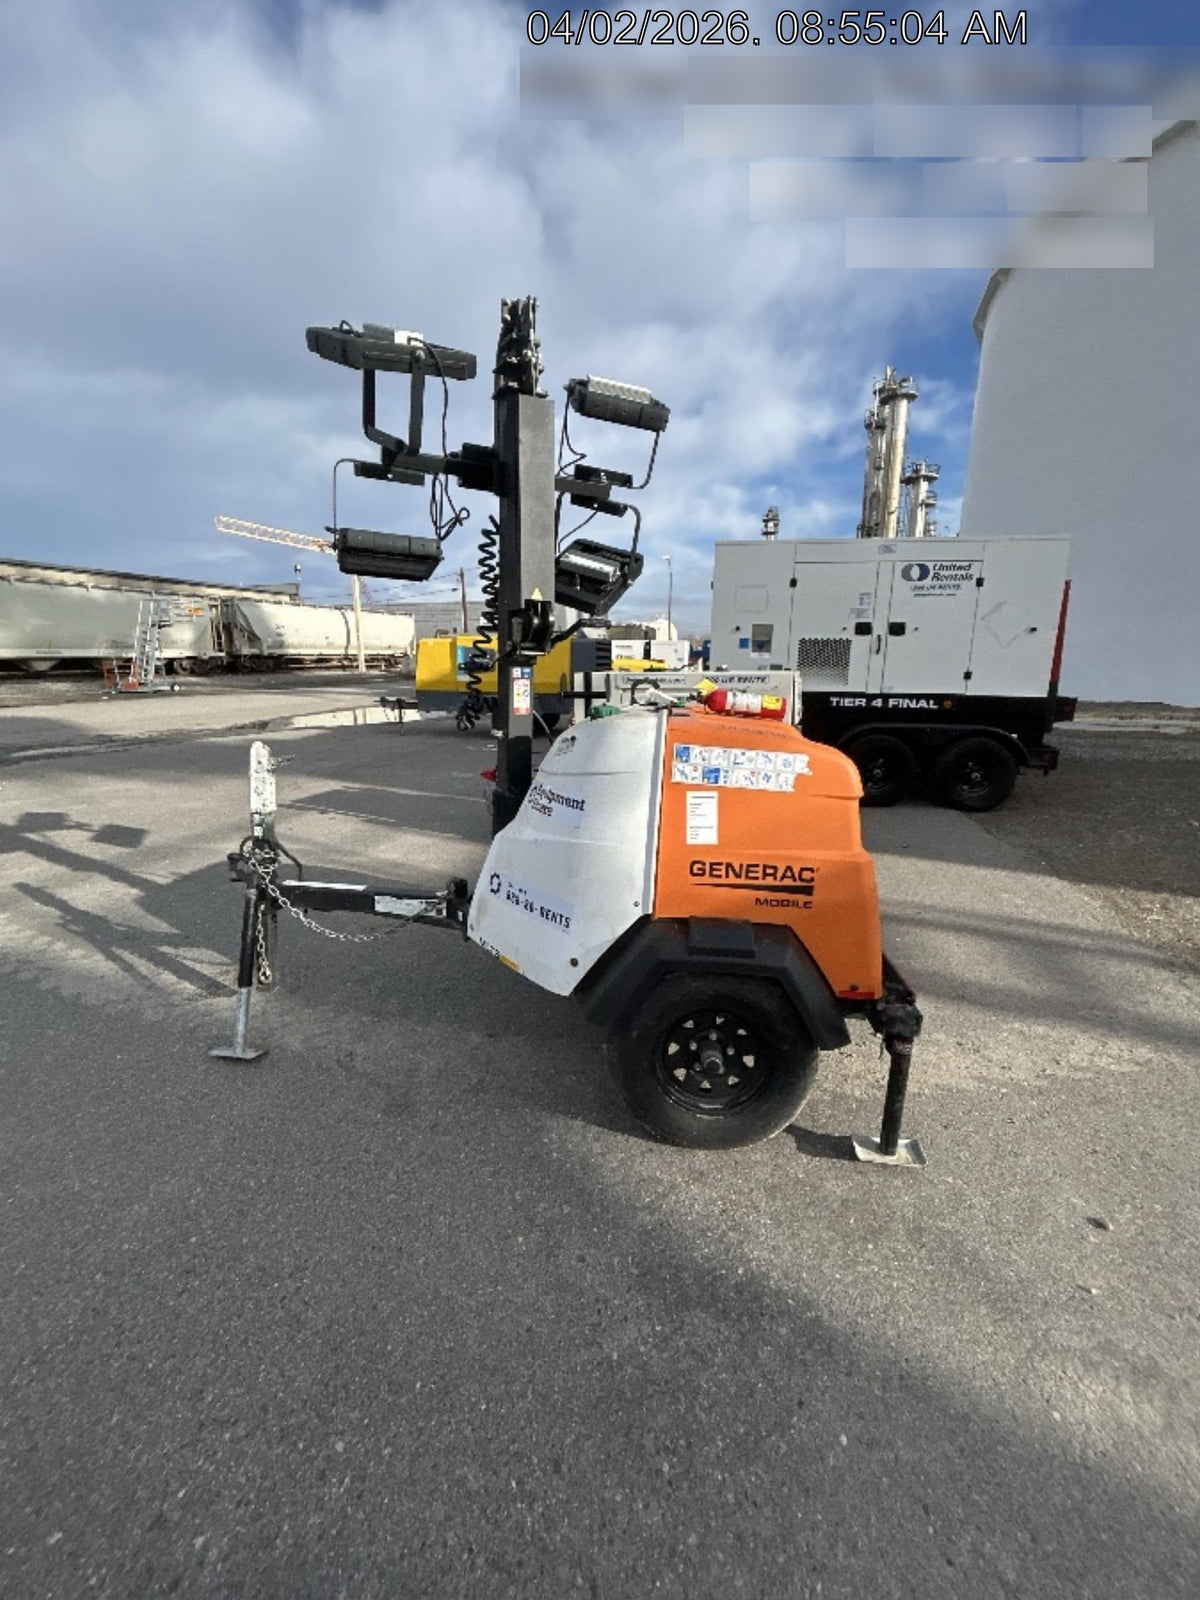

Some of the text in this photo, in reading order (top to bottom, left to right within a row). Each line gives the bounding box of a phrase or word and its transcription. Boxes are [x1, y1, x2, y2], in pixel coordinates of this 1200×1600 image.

[932, 563, 972, 572] United
[931, 572, 974, 582] Rentals
[830, 696, 939, 709] TIER 4 FINAL
[689, 859, 815, 884] GENERAC
[755, 897, 813, 909] MOBILE
